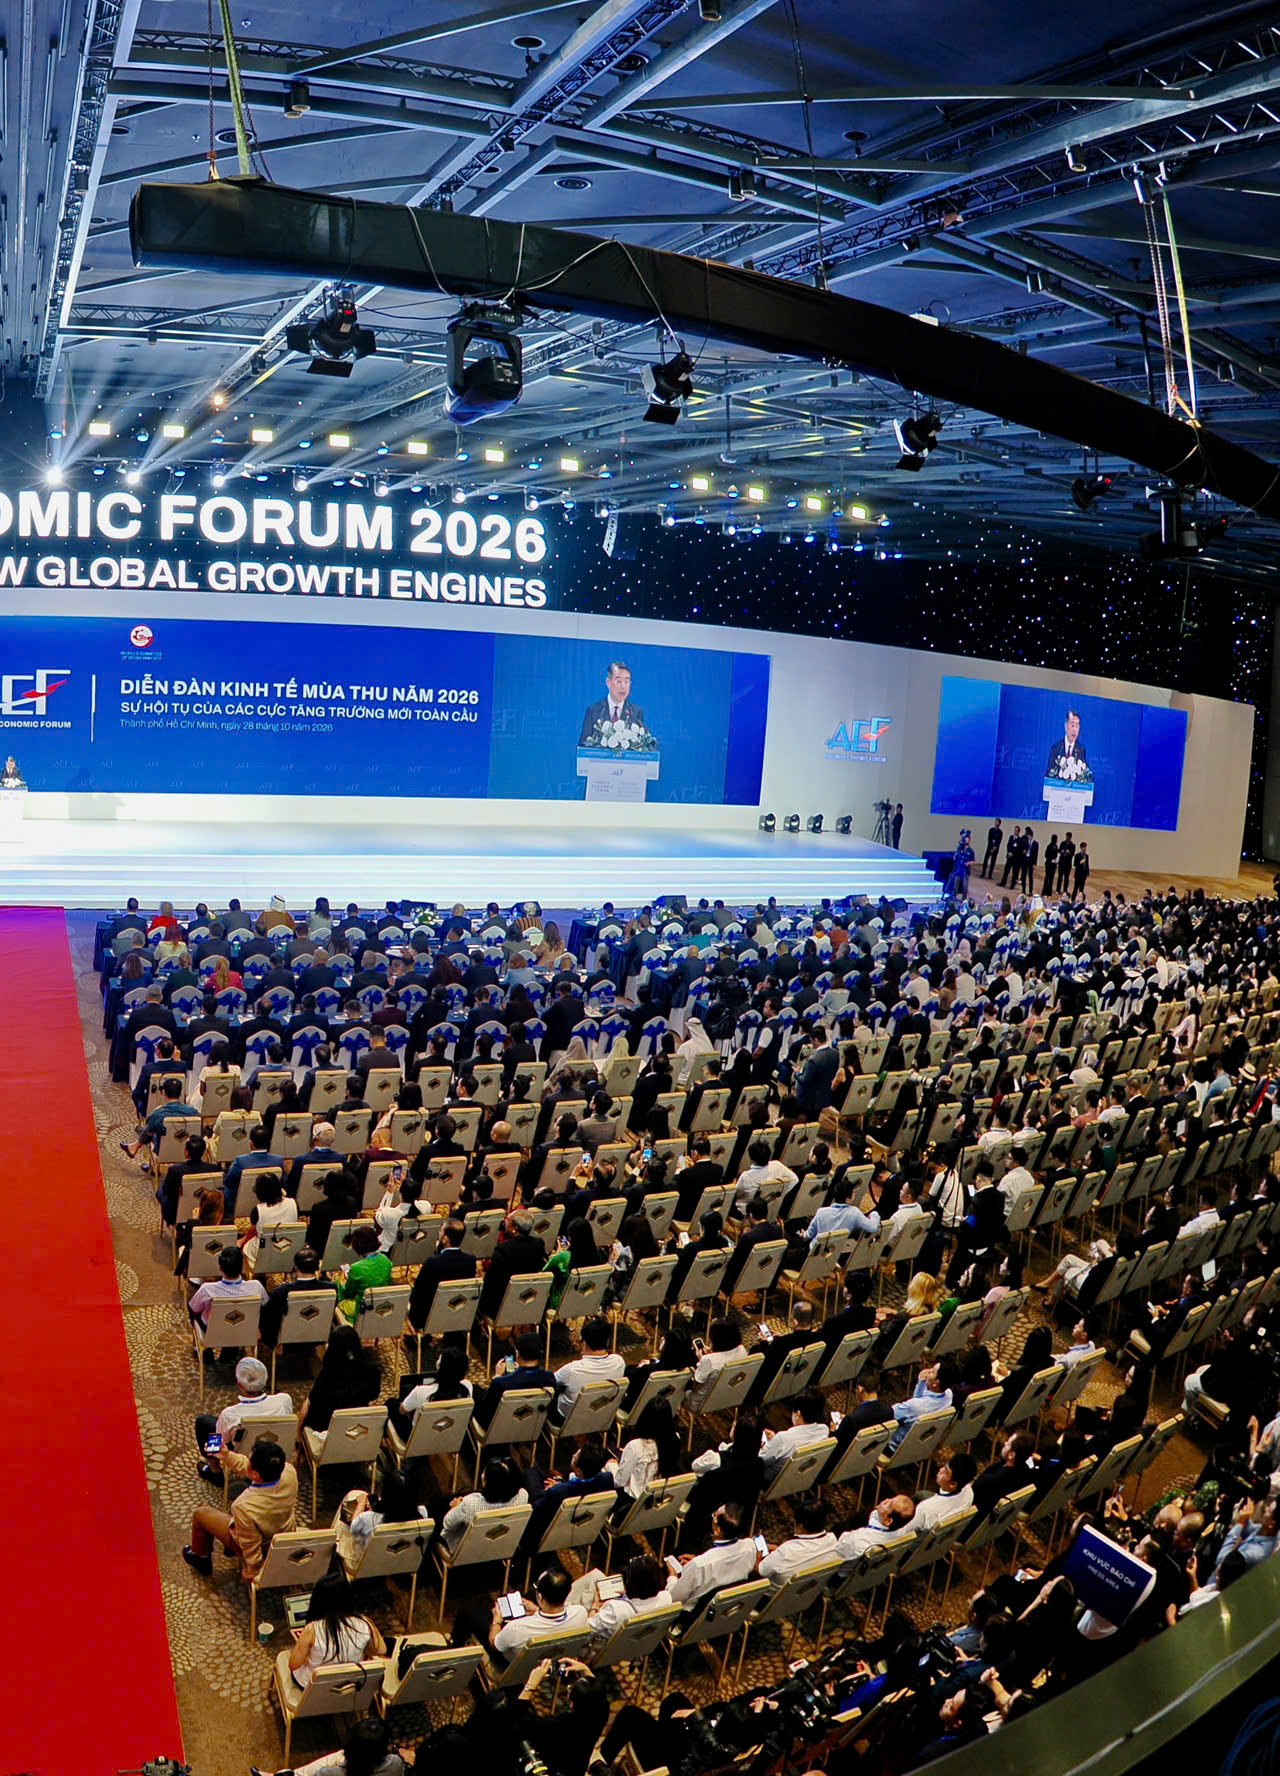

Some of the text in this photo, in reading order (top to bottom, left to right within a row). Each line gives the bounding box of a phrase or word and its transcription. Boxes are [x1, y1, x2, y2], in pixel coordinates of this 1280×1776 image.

[160, 494, 393, 551] FORUM
[410, 508, 547, 563] 2026
[36, 556, 199, 589] GLOBAL
[208, 561, 380, 596] GROWTH
[390, 569, 547, 607] ENGINES
[120, 673, 479, 705] DIỄN ĐÀN KINH TẾ MÙA THU NĂM 2026
[40, 720, 72, 729] FORUM
[121, 700, 142, 715] SỰ
[144, 700, 168, 716] HỘI
[171, 702, 190, 716] TỤ
[193, 701, 222, 715] CỦA
[225, 702, 255, 716] CÁC
[257, 703, 287, 718] CỰC
[289, 704, 326, 717] TĂNG
[387, 706, 413, 720] MỚI
[415, 706, 449, 722] TOÀN
[451, 707, 478, 722] CẦU
[120, 717, 334, 733] Thành phố Hồ Chí Minh, ngày 28 tháng 10 năm 2026
